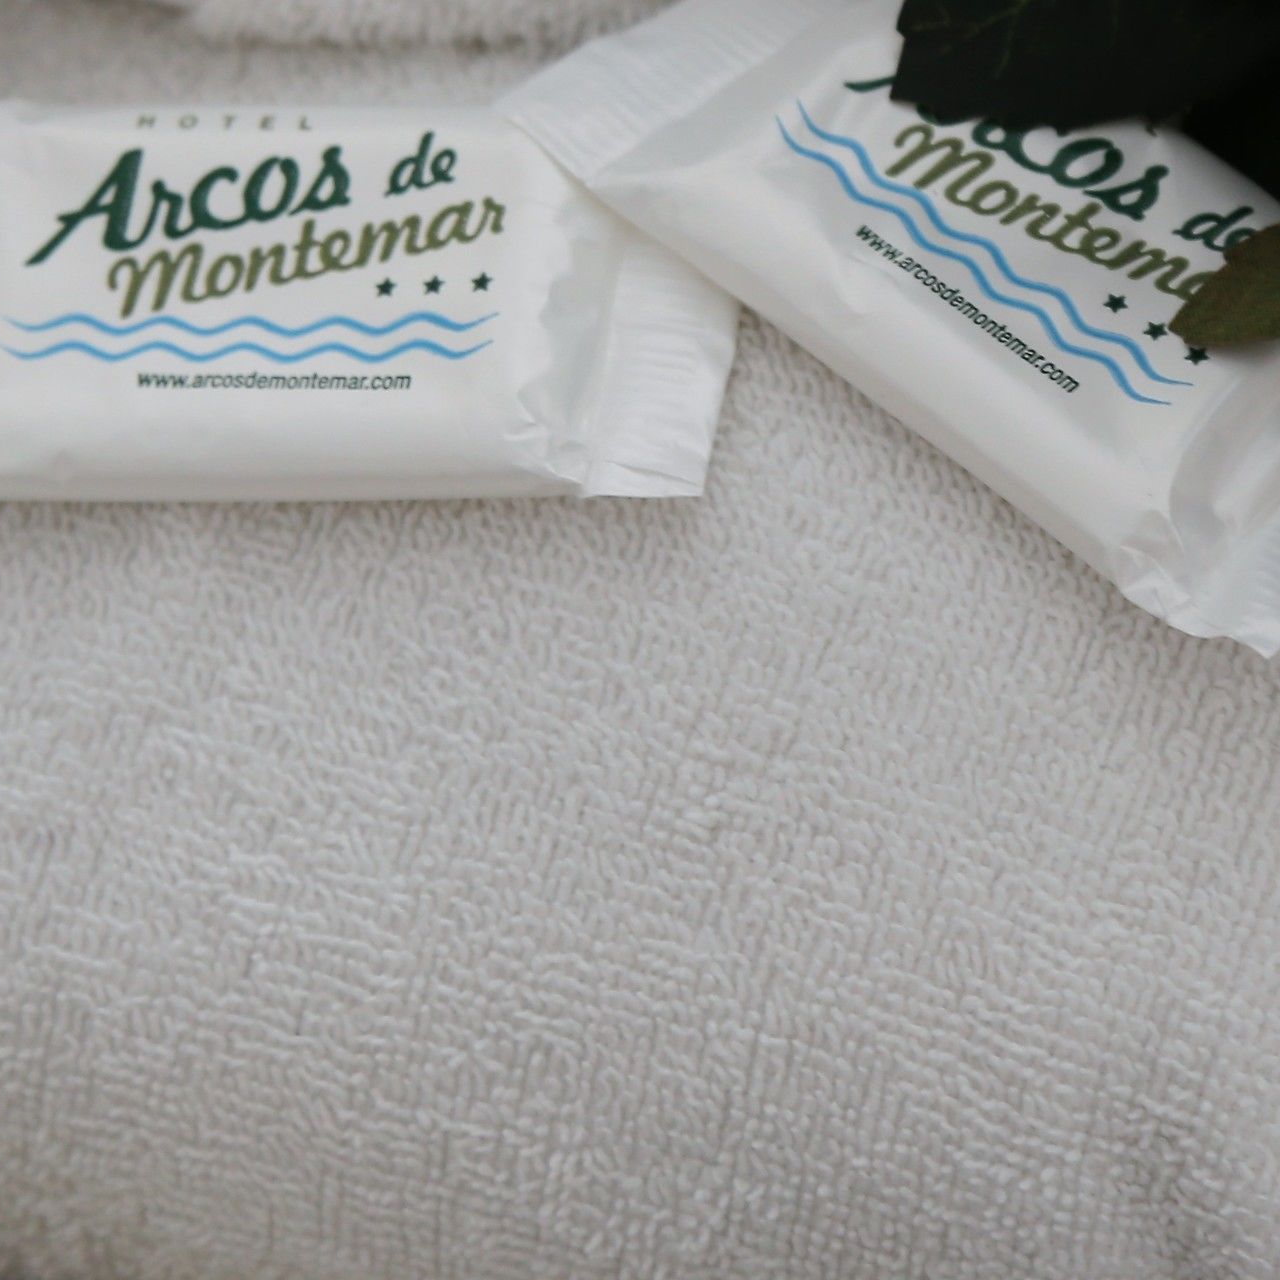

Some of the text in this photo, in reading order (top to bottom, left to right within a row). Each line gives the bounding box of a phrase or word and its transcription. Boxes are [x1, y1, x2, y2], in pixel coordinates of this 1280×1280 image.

[136, 114, 313, 131] HOTEL
[24, 131, 457, 267] Arcos de
[107, 196, 507, 320] Montemar
[855, 223, 1081, 394] www.arcosdemontemar.com
[136, 371, 413, 392] www.arcosdemontemar.com
